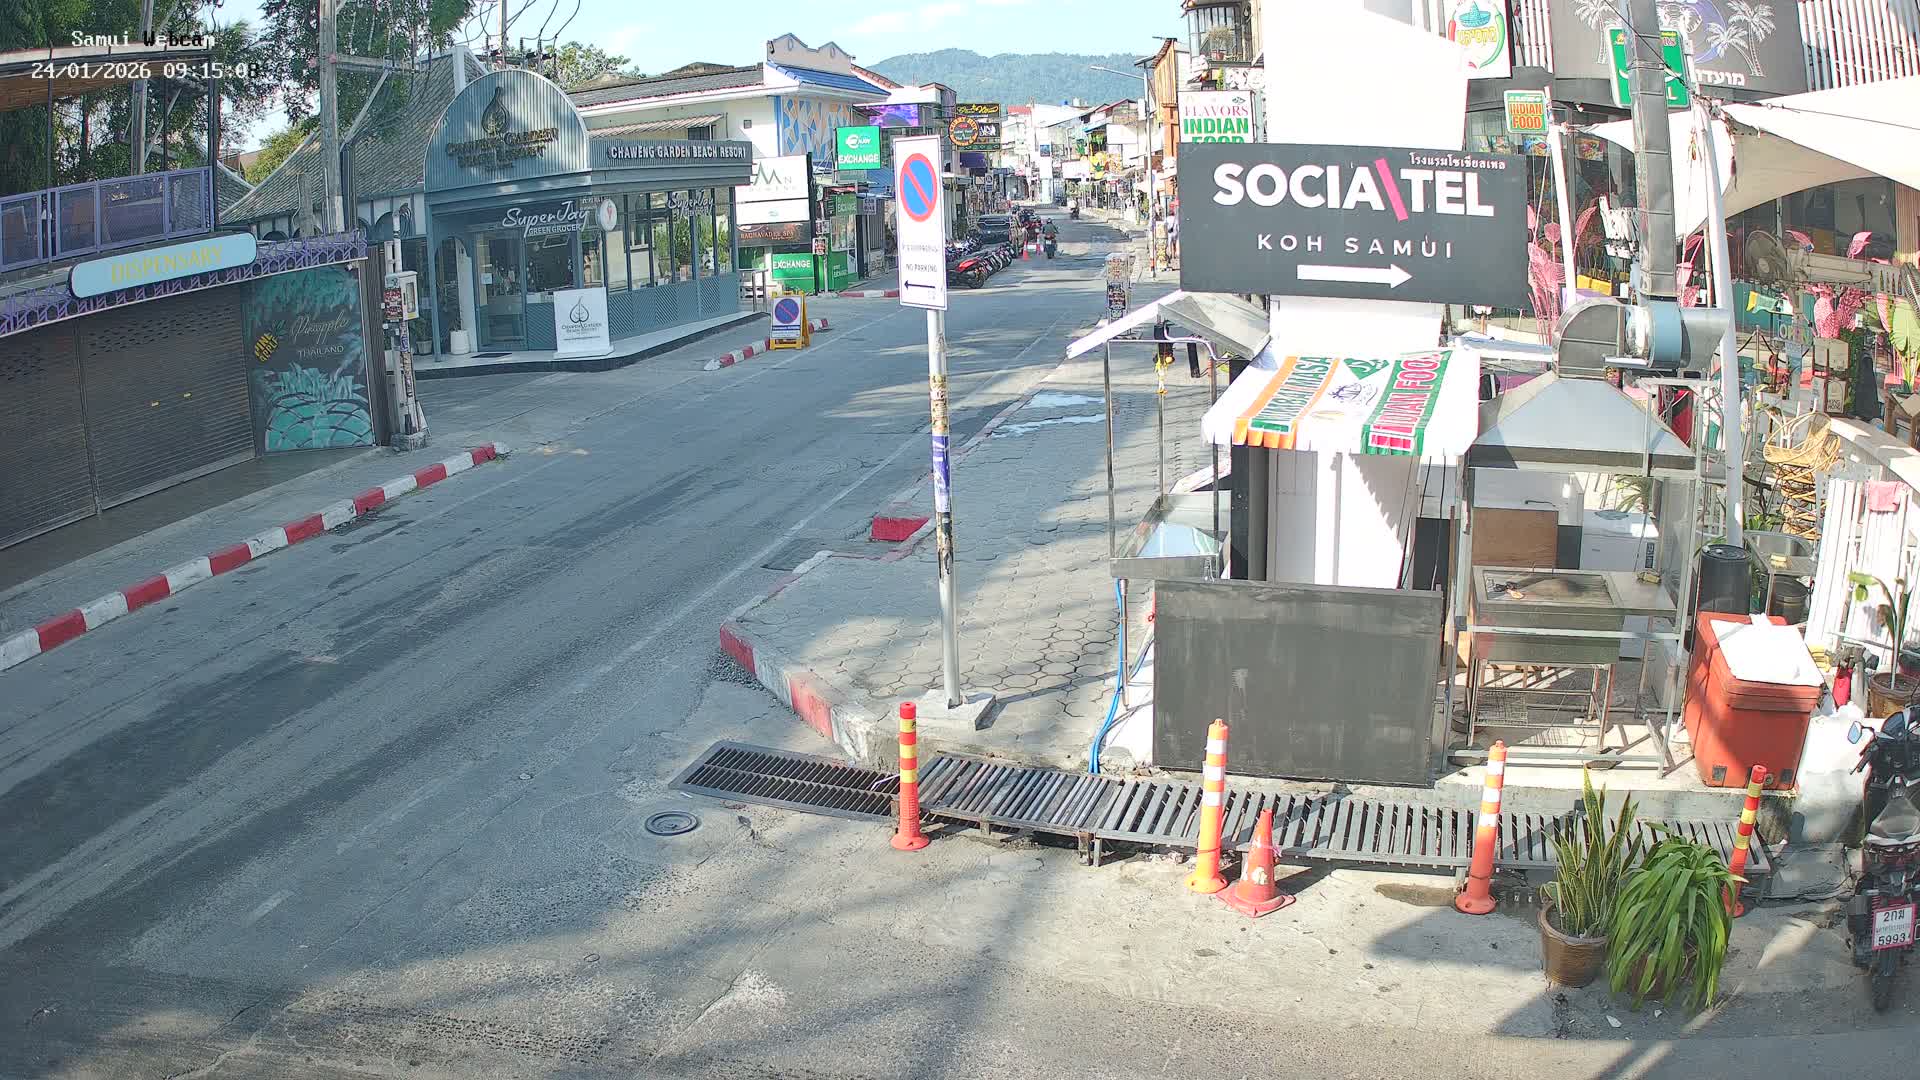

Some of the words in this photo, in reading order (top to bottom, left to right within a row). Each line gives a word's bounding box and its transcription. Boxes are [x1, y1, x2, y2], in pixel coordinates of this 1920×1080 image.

[1185, 105, 1249, 117] FLAVORS
[1510, 103, 1543, 115] INDIAN
[1183, 117, 1249, 134] INDIAN
[1512, 115, 1542, 129] FOOD
[610, 145, 655, 159] CHAWENG
[657, 145, 691, 159] GARDEN
[693, 145, 718, 158] BEACH
[719, 146, 747, 158] RESORT
[838, 154, 880, 164] EXCHANGE
[1257, 234, 1323, 252] KOH
[1344, 236, 1452, 258] SAMUI
[111, 243, 223, 285] DISPENSARY
[773, 260, 811, 269] EXCHANGE
[914, 264, 938, 273] PARKING
[298, 346, 344, 357] THAILAND
[1394, 354, 1440, 389] FOO
[1879, 932, 1906, 946] 5993
